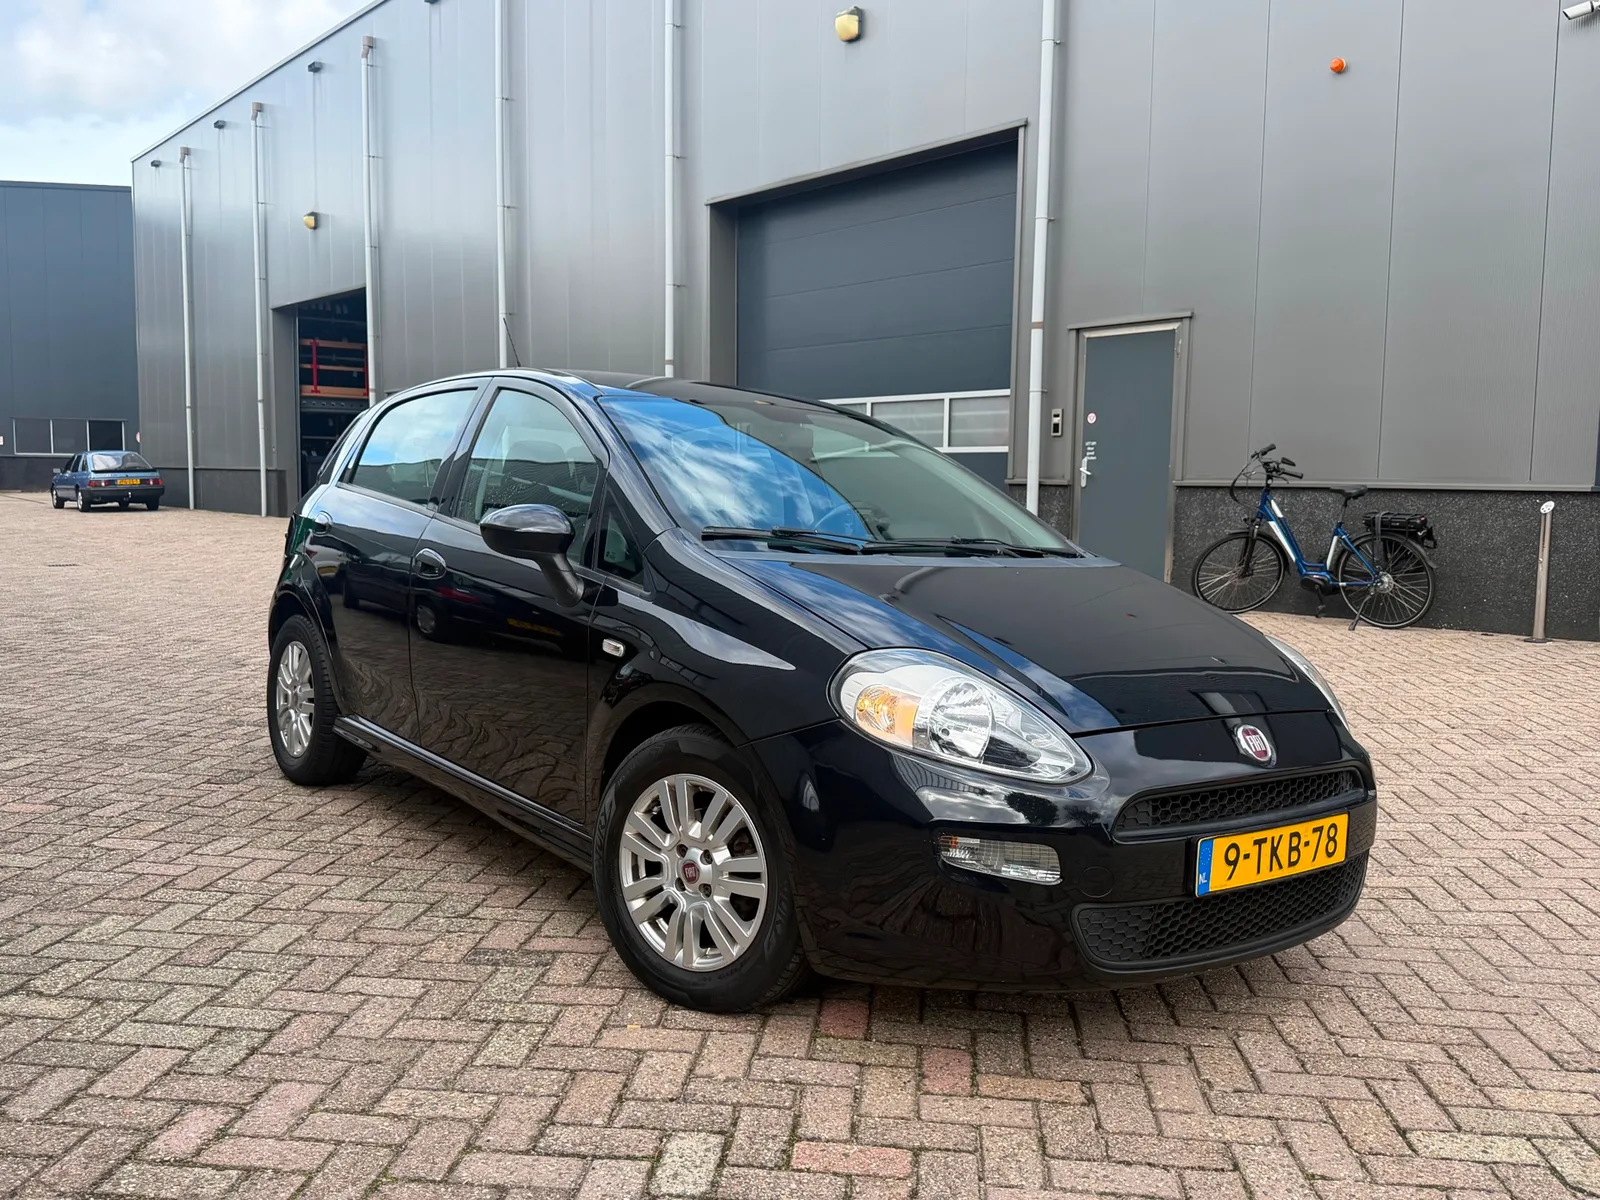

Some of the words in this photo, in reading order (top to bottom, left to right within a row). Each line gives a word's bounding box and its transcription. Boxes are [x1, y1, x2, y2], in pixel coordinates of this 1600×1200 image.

[1244, 734, 1267, 752] FIAT
[1224, 823, 1338, 881] 9-TKB-78
[1198, 872, 1208, 885] NL
